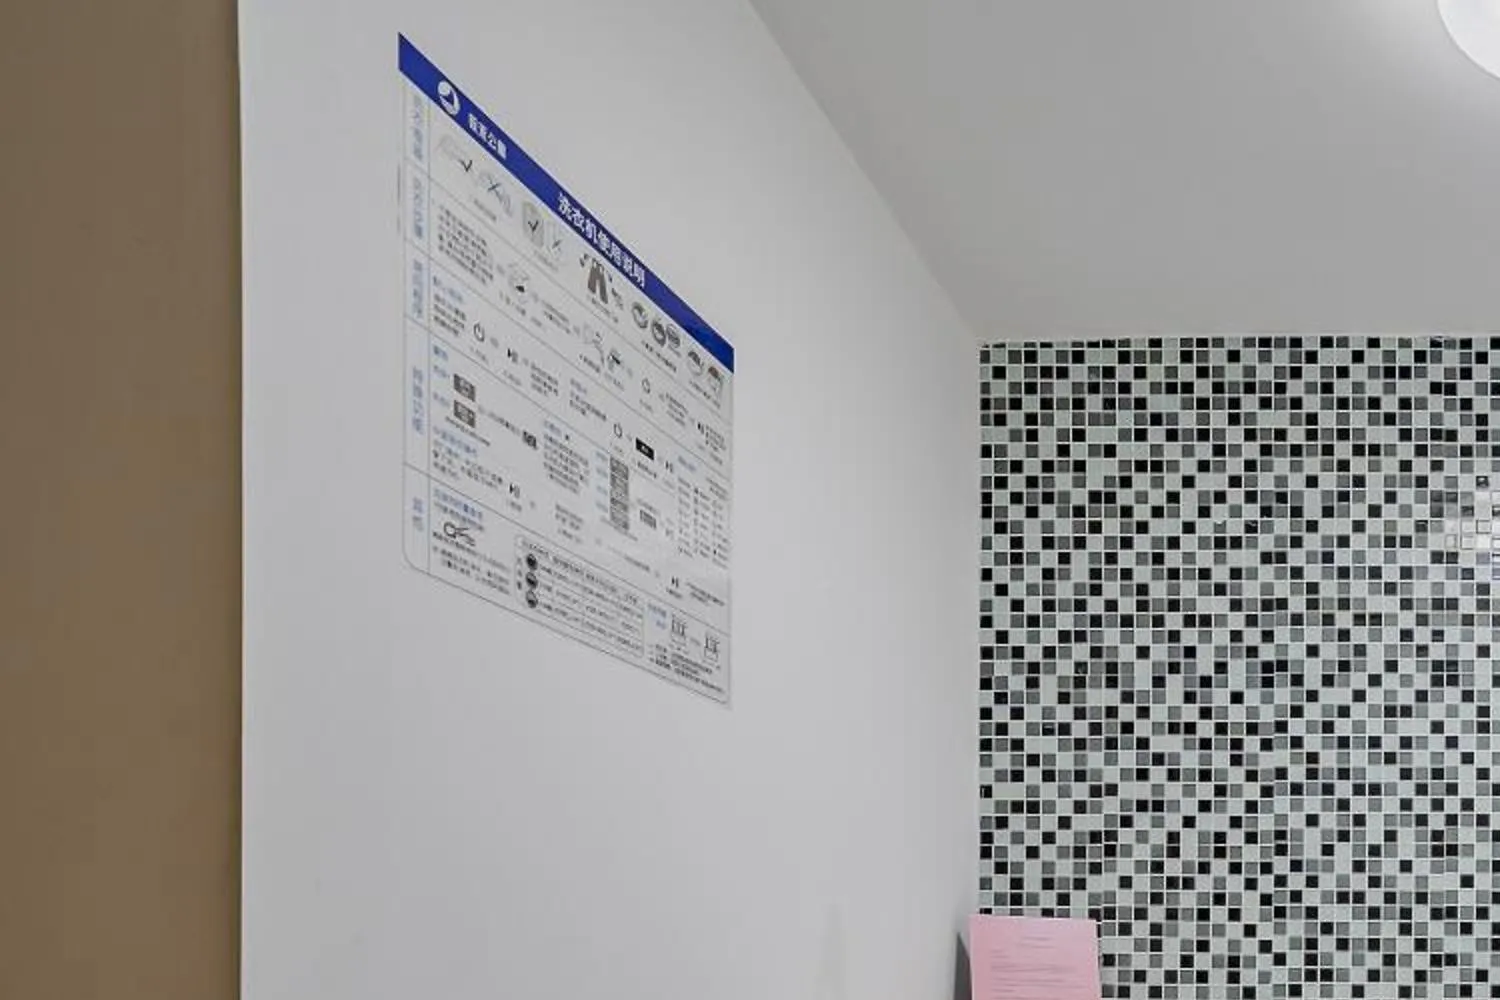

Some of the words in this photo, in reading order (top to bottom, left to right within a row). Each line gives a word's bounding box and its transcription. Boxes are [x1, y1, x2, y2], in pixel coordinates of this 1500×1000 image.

[558, 192, 645, 289] 洗衣机使用说明
